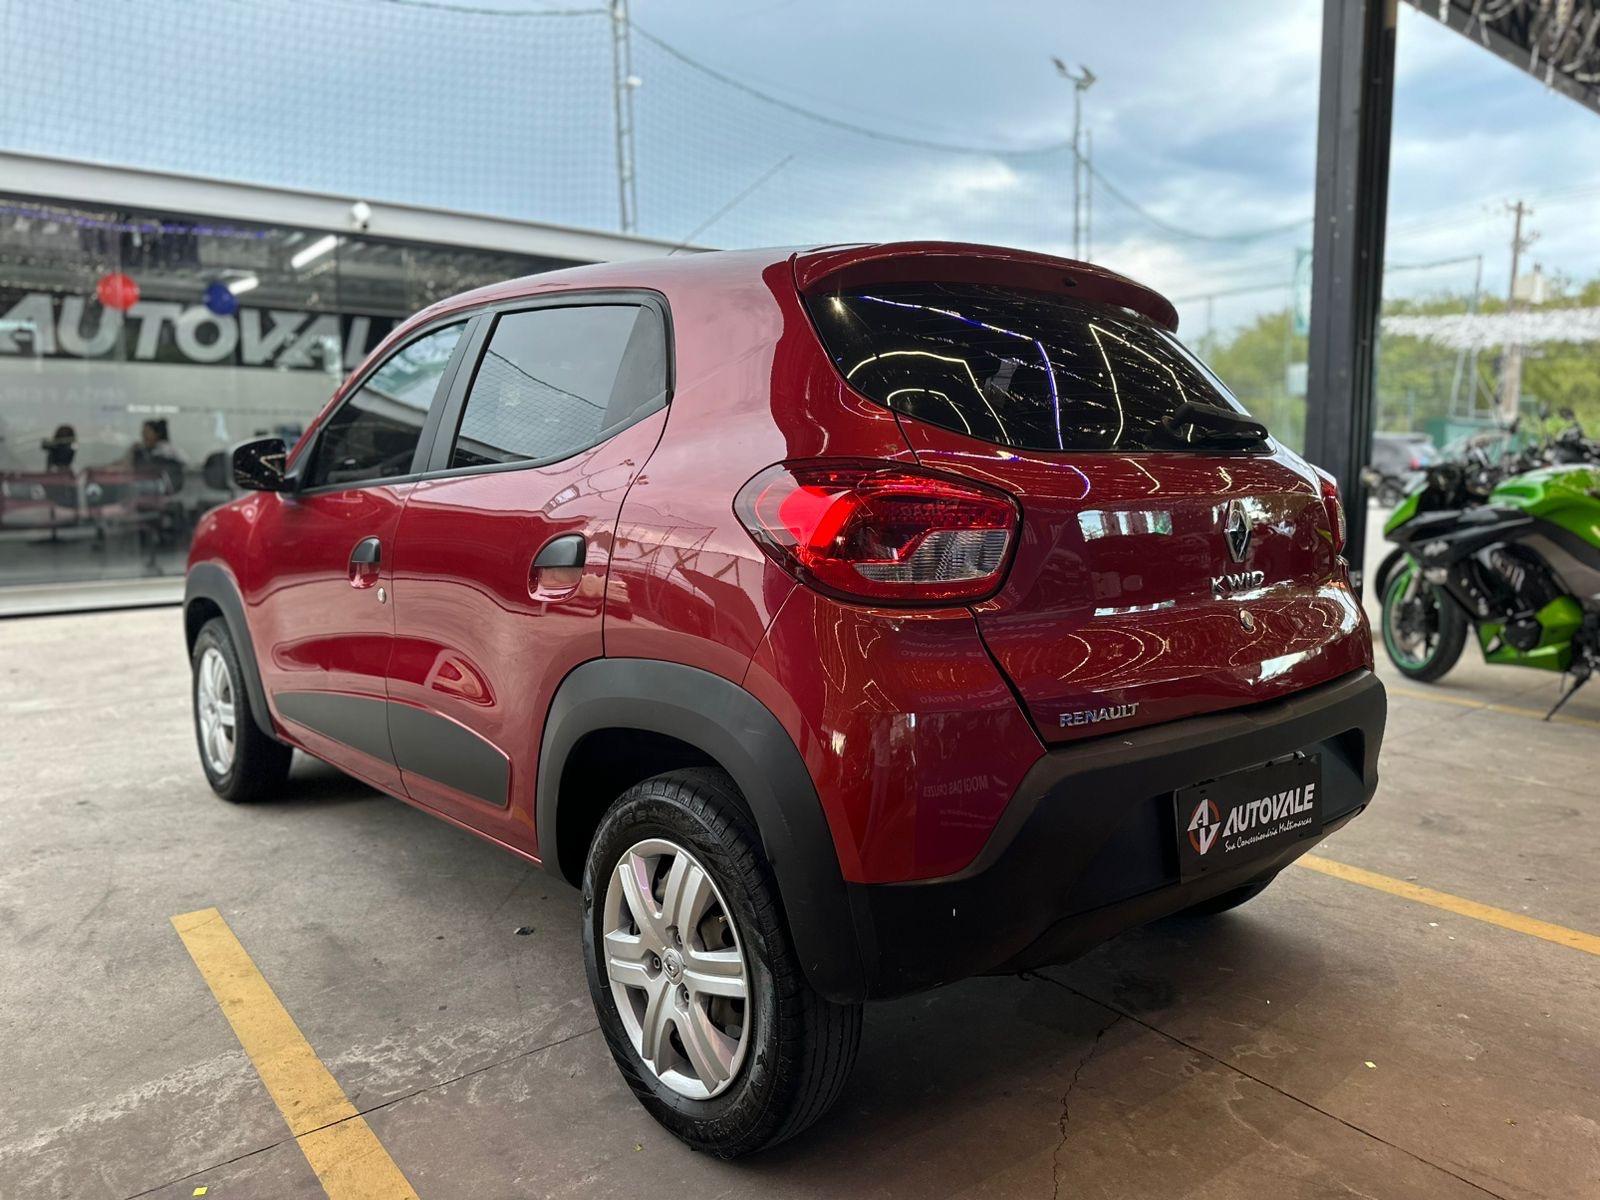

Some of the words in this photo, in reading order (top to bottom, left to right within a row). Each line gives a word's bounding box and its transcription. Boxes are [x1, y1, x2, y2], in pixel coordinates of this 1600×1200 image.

[0, 293, 402, 370] AUTOVAL
[1210, 570, 1264, 592] KWID
[1059, 702, 1139, 727] RENAULT
[1222, 783, 1315, 837] AUTOVALE
[1225, 840, 1236, 853] Sua
[1279, 817, 1312, 834] Multimarcas
